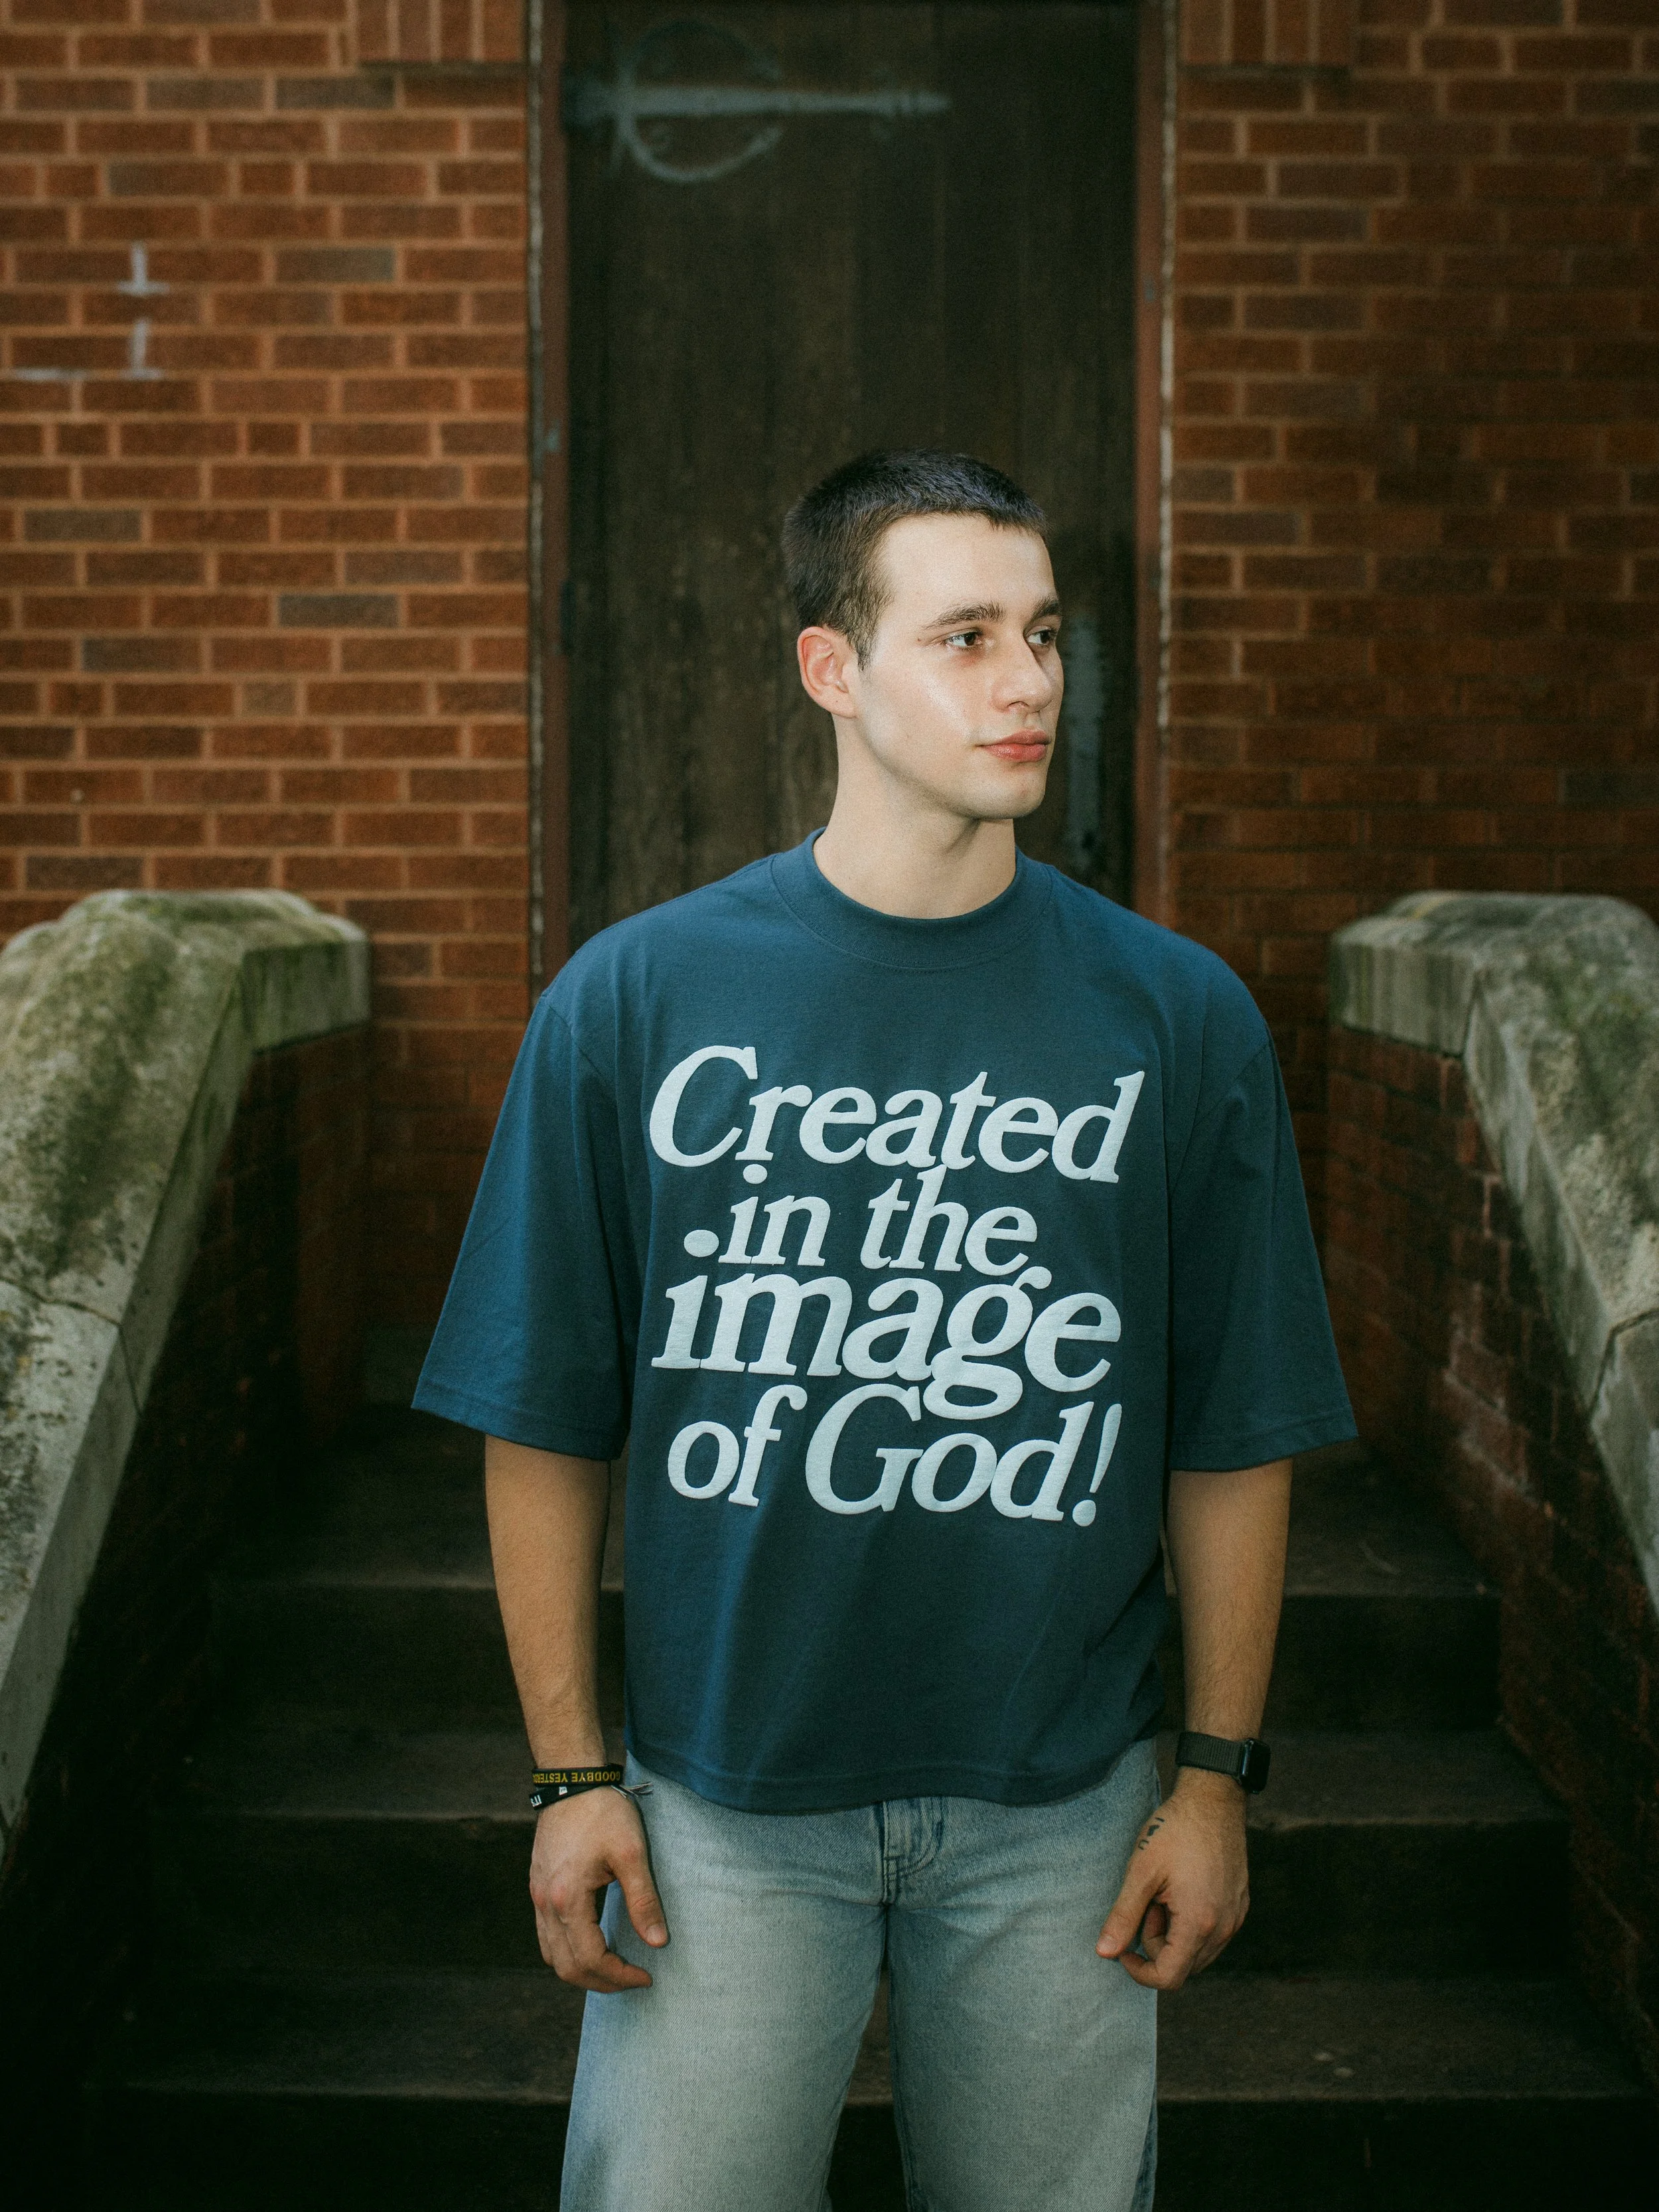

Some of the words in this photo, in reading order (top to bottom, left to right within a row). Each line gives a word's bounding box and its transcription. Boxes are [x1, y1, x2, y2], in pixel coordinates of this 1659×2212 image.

[649, 1045, 1144, 1183] Created
[718, 1162, 831, 1266] in
[860, 1164, 1037, 1276] the
[651, 1230, 1121, 1420] image
[668, 1384, 808, 1507] of
[805, 1383, 1122, 1527] God!
[571, 1771, 620, 1783] GOODBYE
